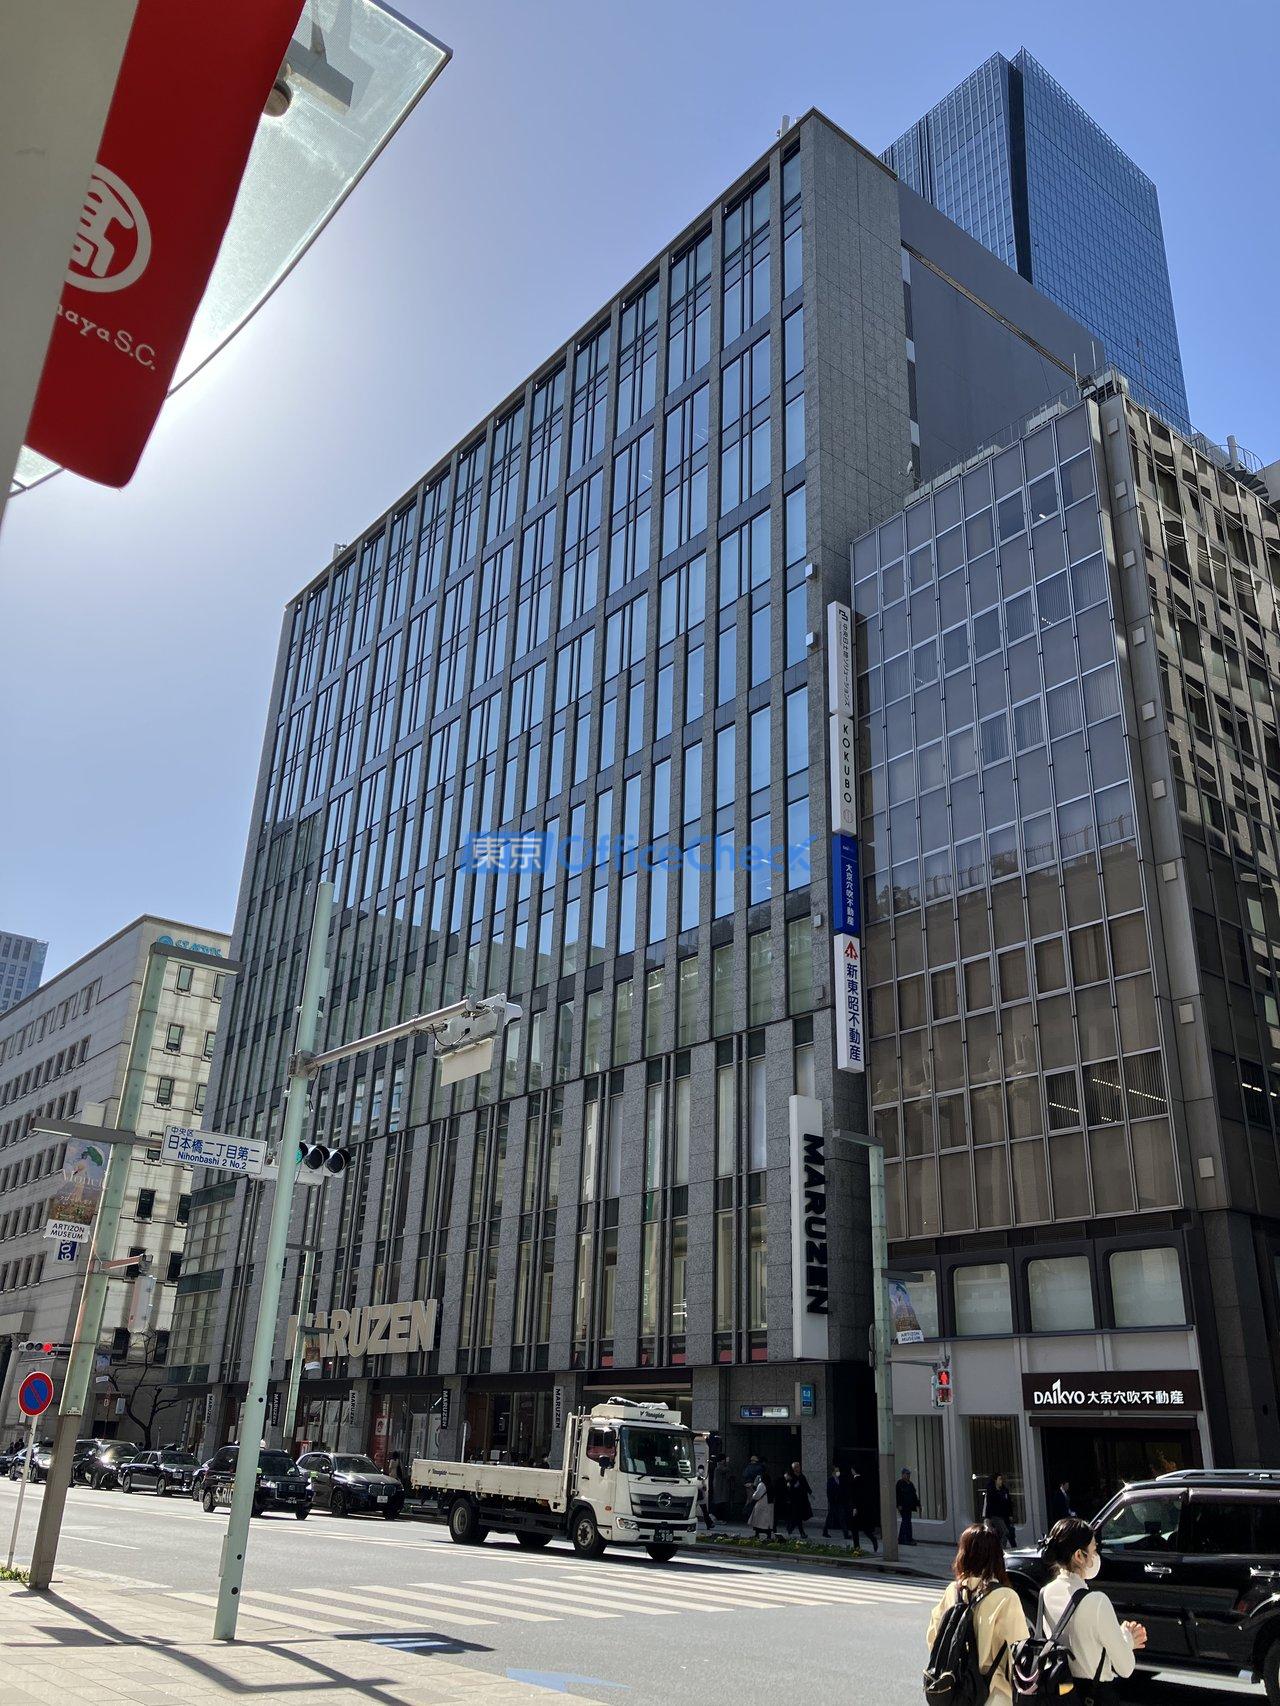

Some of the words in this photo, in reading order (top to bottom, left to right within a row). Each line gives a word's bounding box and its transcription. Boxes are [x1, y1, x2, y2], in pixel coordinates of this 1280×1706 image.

[842, 724, 852, 803] KOKUBO
[846, 963, 861, 1062] 新東昭不動産
[171, 1126, 194, 1137] 中央区
[168, 1134, 260, 1163] 日本橋二丁目第二
[177, 1151, 219, 1166] Nihonbashi
[229, 1160, 247, 1170] No.2
[50, 1229, 83, 1240] MUSEUM
[52, 1222, 86, 1233] ARTIZON
[803, 1133, 829, 1315] MARUZEN
[441, 1390, 449, 1428] MARUZEN
[1087, 1390, 1185, 1405] 大京穴吹不動産
